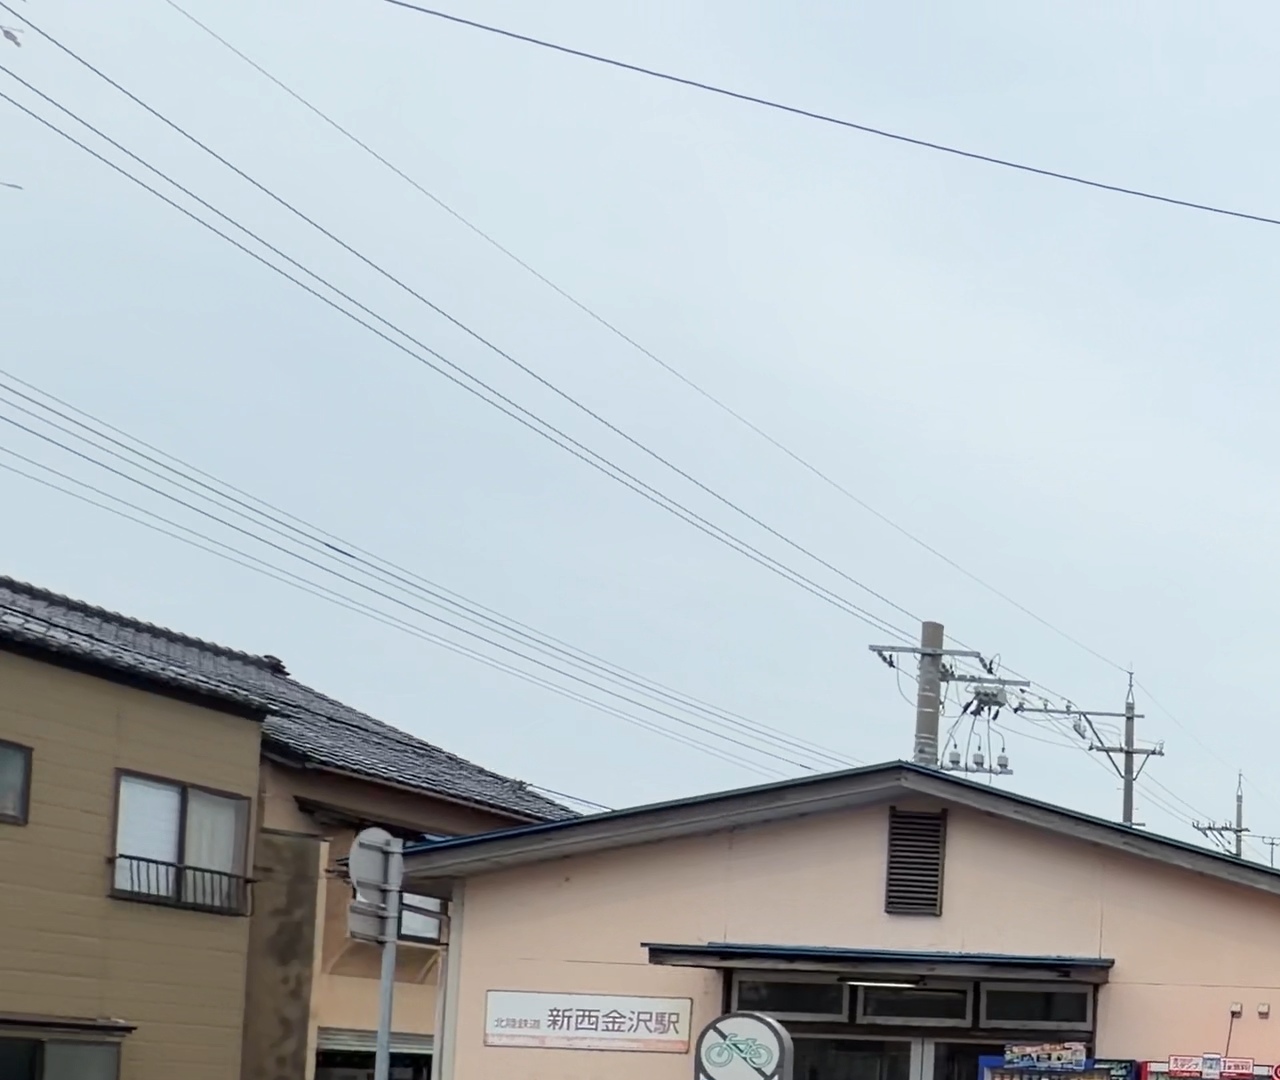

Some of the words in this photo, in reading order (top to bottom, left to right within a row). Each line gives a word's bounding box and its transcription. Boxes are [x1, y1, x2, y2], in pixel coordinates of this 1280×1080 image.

[547, 1007, 681, 1035] 新西金沢駅
